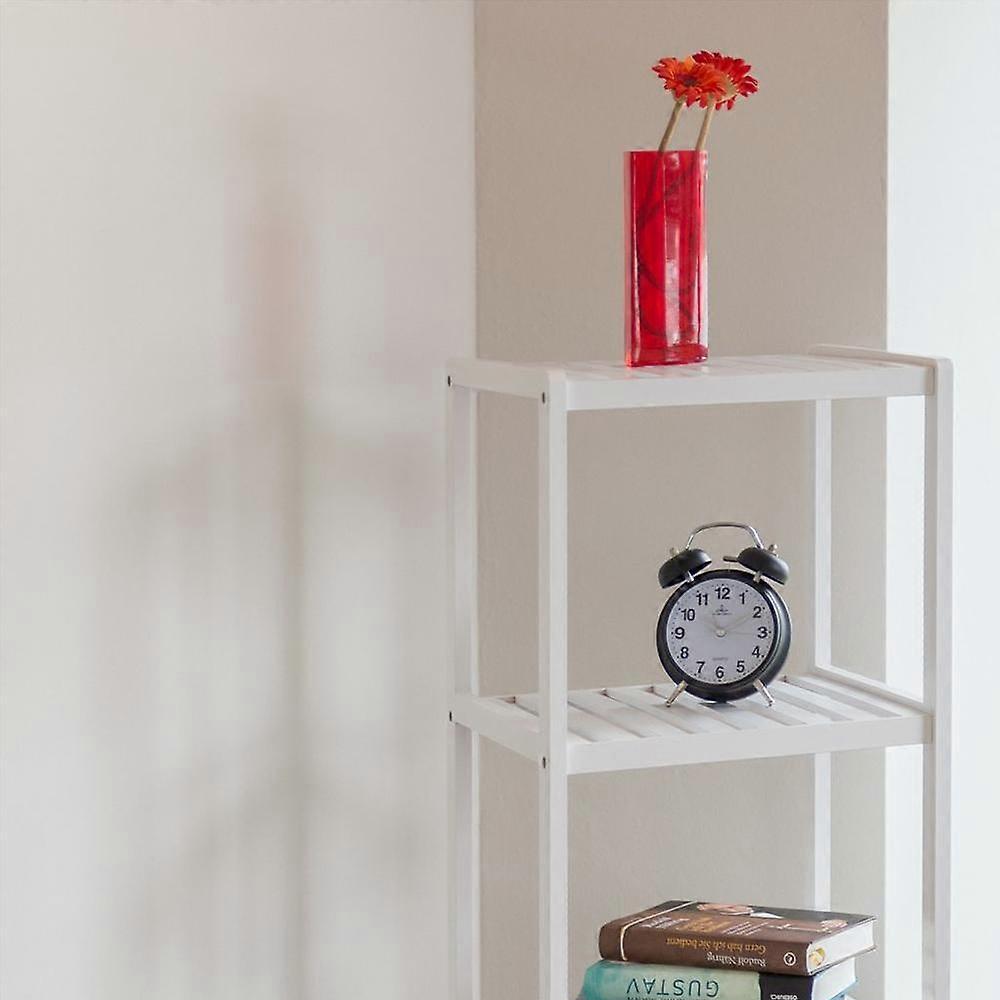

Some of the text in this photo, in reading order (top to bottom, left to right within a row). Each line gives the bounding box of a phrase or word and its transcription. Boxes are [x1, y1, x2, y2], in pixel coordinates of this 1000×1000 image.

[696, 593, 708, 606] 11
[715, 587, 731, 600] 12
[739, 592, 745, 605] 1
[681, 608, 695, 621] 10
[753, 606, 761, 618] 2
[675, 627, 685, 639] 9
[757, 626, 768, 639] 3
[680, 646, 689, 659] 8
[752, 646, 760, 658] 4
[696, 661, 705, 673] 7
[715, 666, 724, 678] 6
[736, 660, 745, 673] 5
[626, 979, 719, 998] GUSTAV
